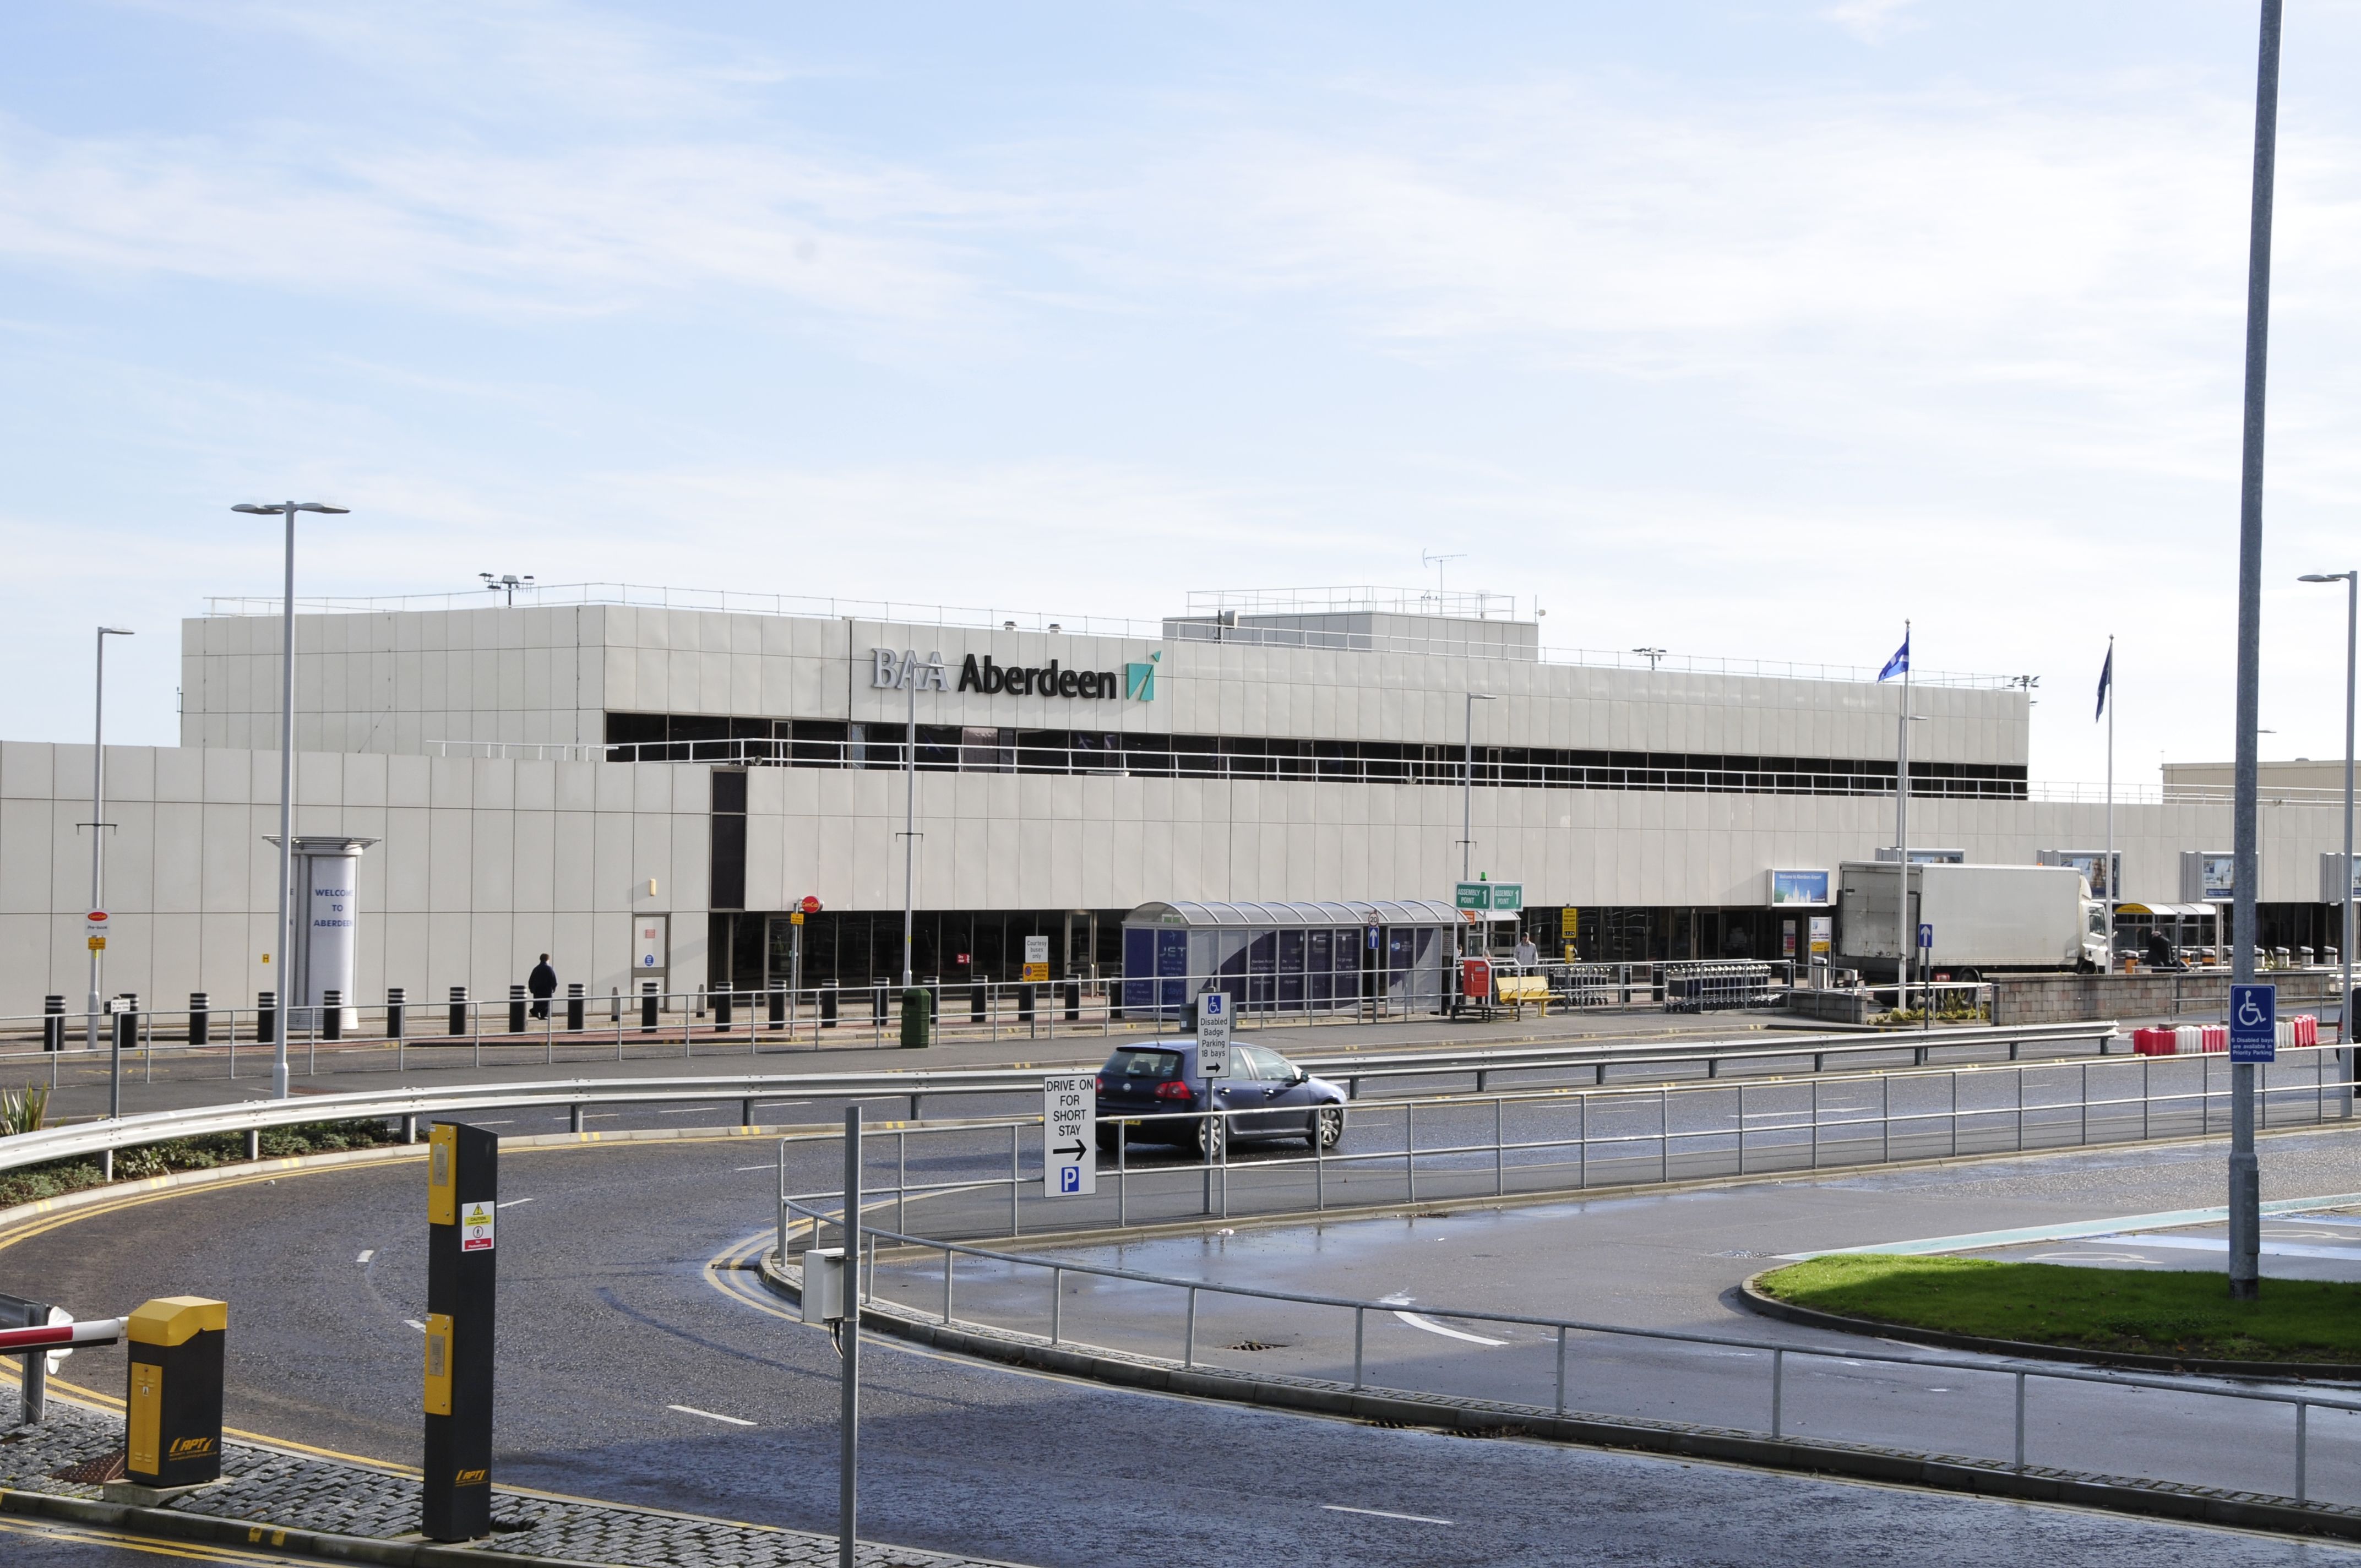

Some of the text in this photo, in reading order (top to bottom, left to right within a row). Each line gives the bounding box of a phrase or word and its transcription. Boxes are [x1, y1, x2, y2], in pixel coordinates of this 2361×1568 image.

[871, 648, 1117, 699] BAA Aberdeen
[1482, 890, 1487, 905] 1
[1515, 890, 1519, 905] 1
[1159, 947, 1186, 957] JET
[1168, 987, 1183, 996] days
[1204, 1028, 1223, 1037] Badge
[1202, 1039, 1225, 1048] Parking
[1211, 1049, 1226, 1058] bays
[1047, 1079, 1094, 1092] DRIVE ON
[1060, 1095, 1080, 1106] FOR
[1053, 1109, 1086, 1121] SHORT
[1059, 1124, 1081, 1136] STAY
[1064, 1168, 1077, 1191] P
